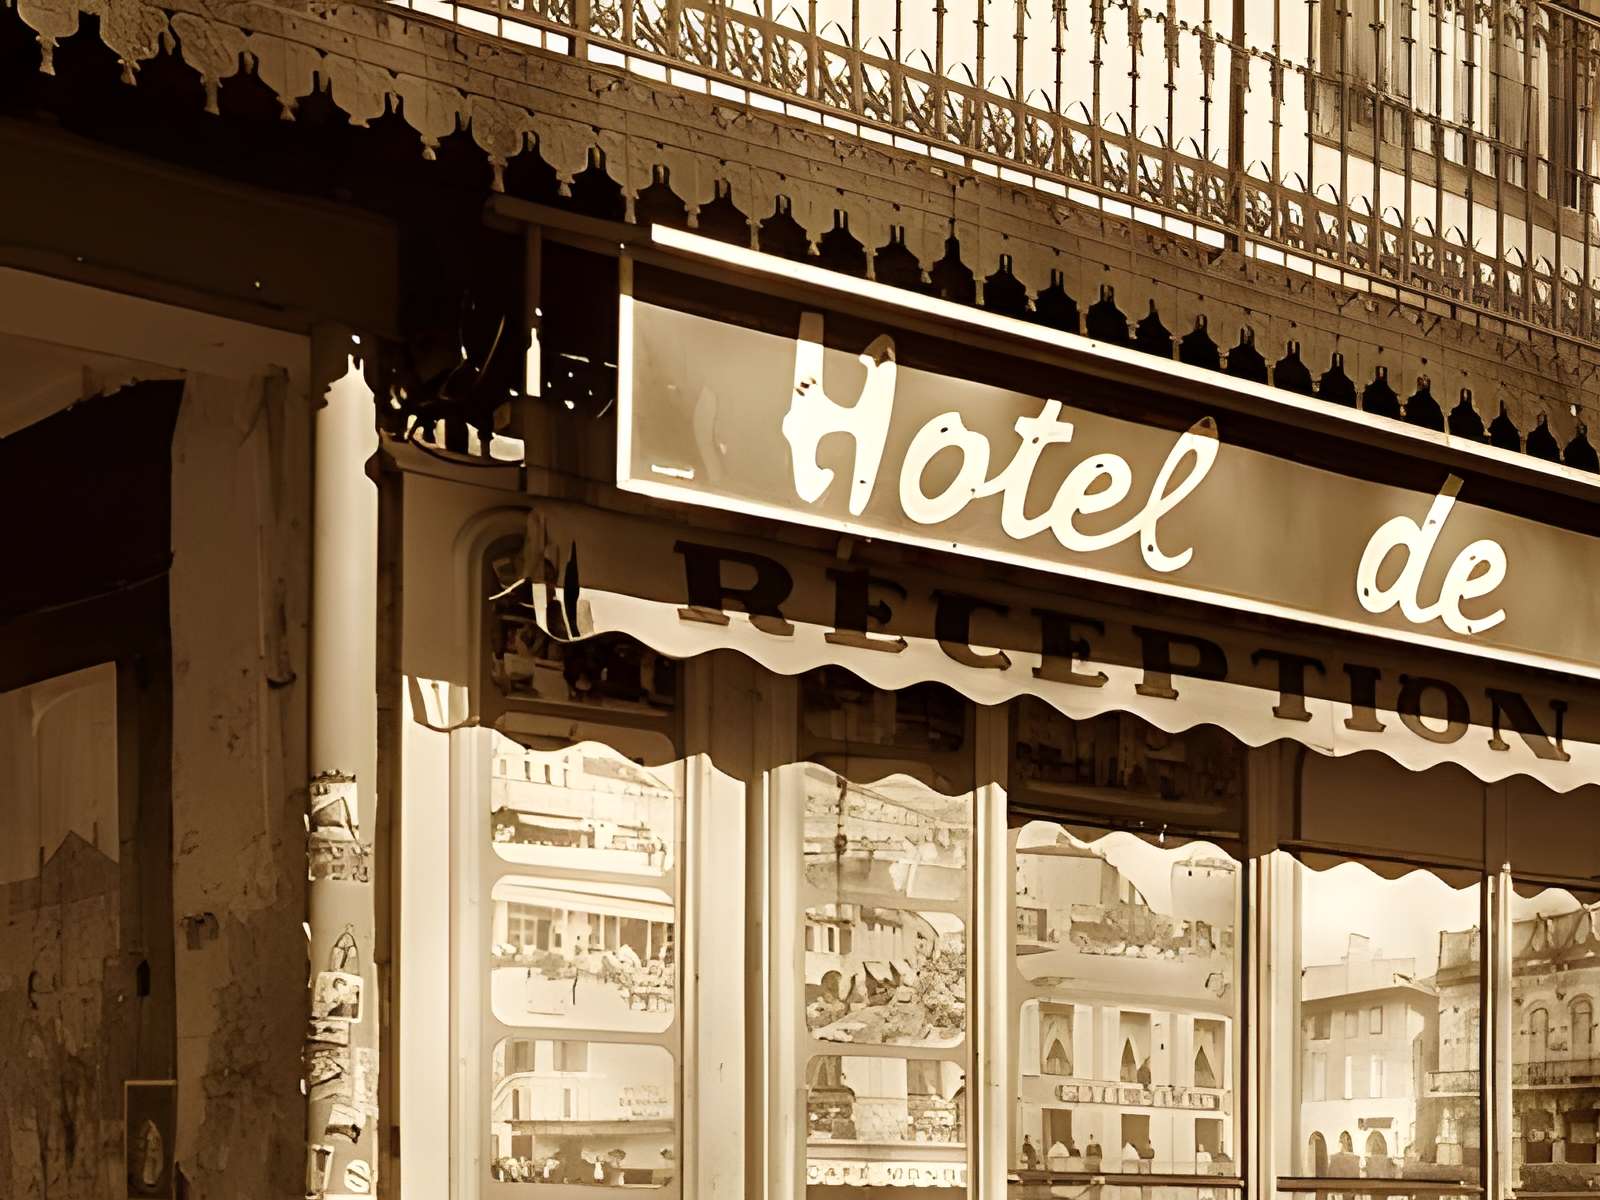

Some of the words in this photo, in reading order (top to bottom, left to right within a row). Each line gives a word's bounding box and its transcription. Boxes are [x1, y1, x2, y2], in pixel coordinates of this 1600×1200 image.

[783, 312, 1220, 573] Hotel
[1356, 474, 1508, 636] de
[674, 540, 1571, 763] RECEPTION
